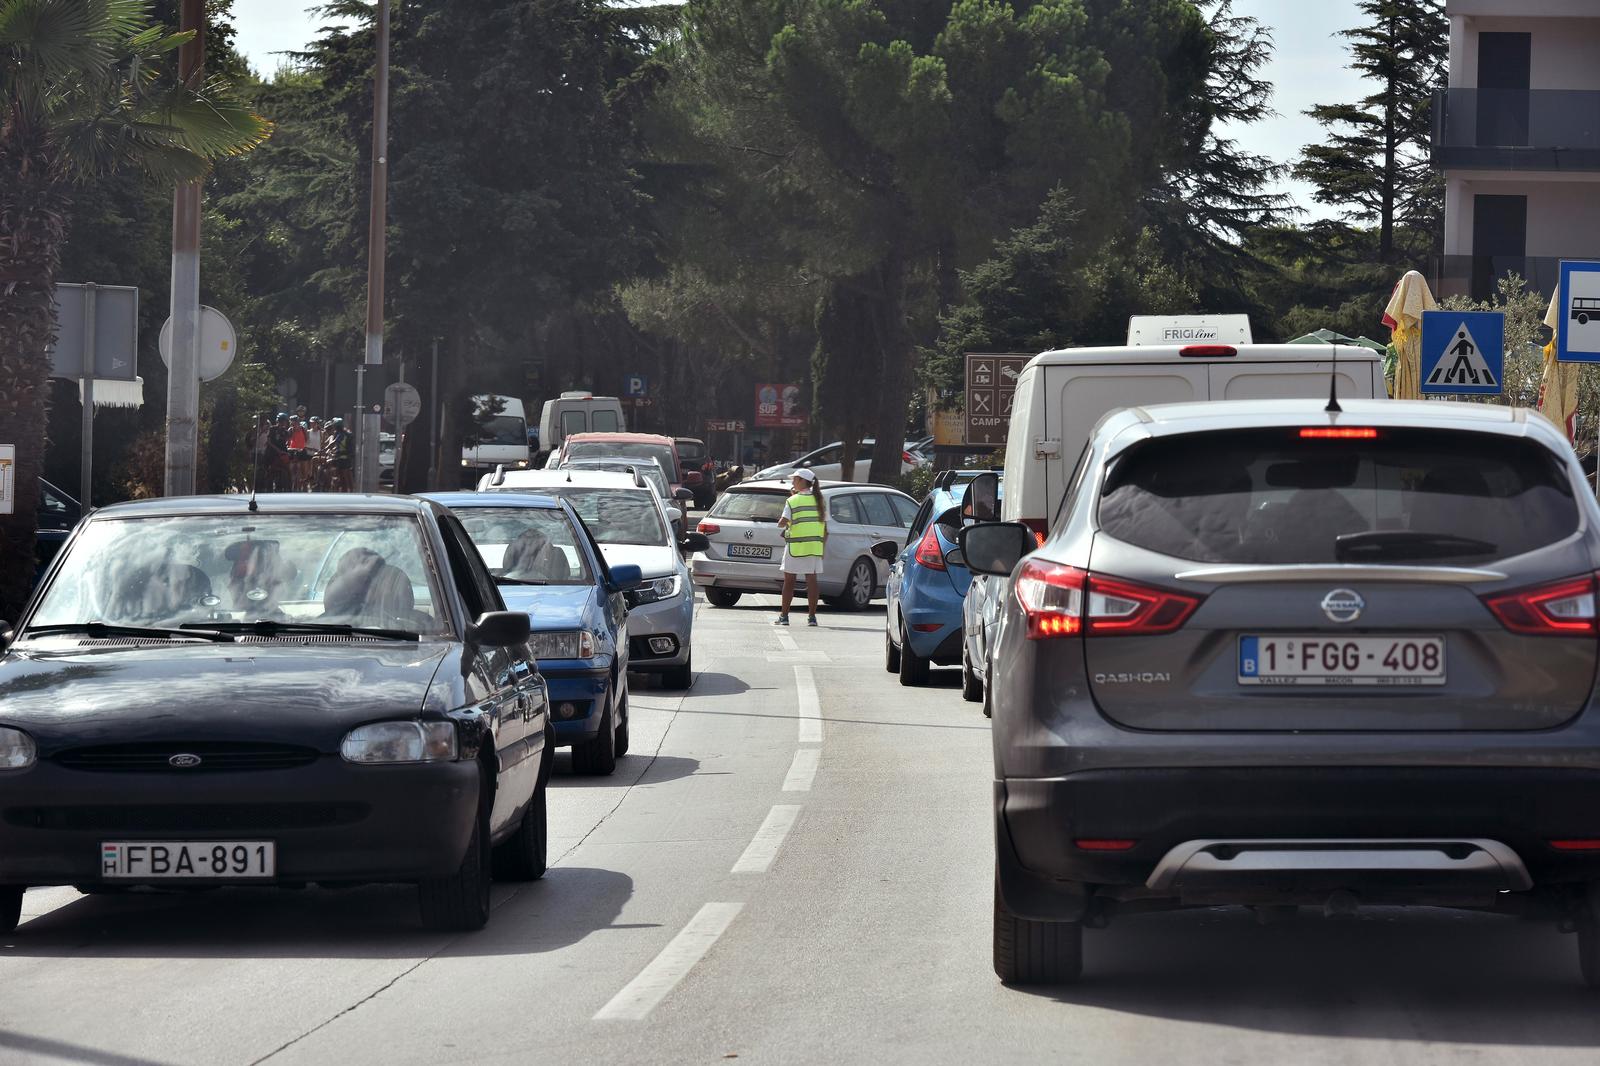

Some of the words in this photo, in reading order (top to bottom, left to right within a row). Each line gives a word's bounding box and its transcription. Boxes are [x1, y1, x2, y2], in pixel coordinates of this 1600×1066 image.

[630, 377, 642, 394] P
[759, 402, 777, 414] SUP
[970, 417, 1001, 426] CAMP
[751, 547, 770, 556] 2245
[1244, 659, 1255, 673] B
[1265, 642, 1440, 671] 1-FGG-408
[1094, 672, 1171, 684] QASHQAI
[175, 755, 194, 766] Ford
[103, 860, 117, 874] H
[127, 845, 266, 874] FBA-891
